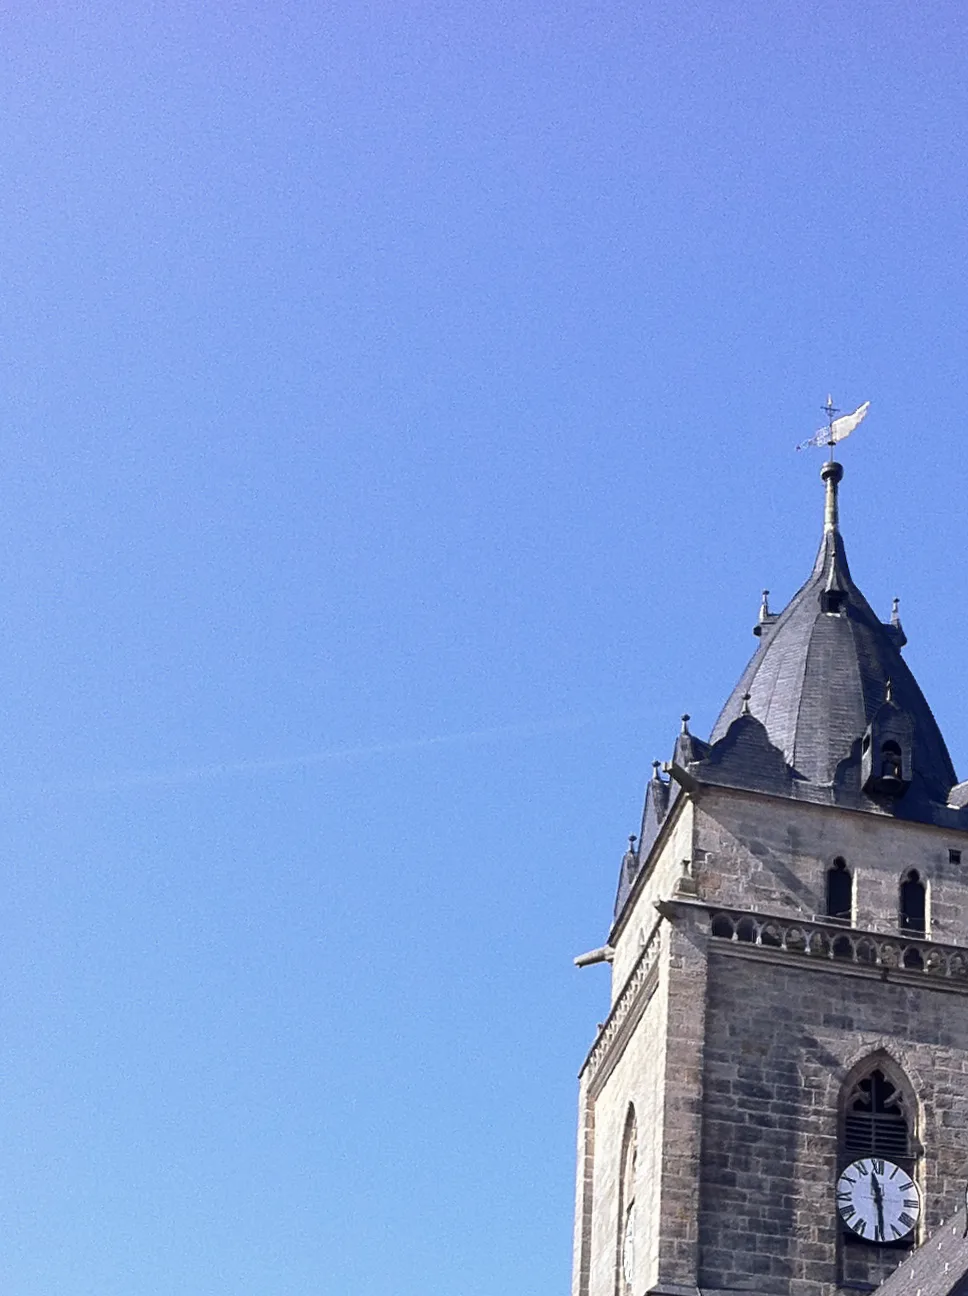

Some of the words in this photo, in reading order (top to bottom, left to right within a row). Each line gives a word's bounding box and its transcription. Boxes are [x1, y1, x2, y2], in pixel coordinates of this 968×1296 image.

[889, 1166, 899, 1180] I
[840, 1172, 857, 1188] X
[898, 1181, 914, 1192] II
[903, 1199, 919, 1209] III
